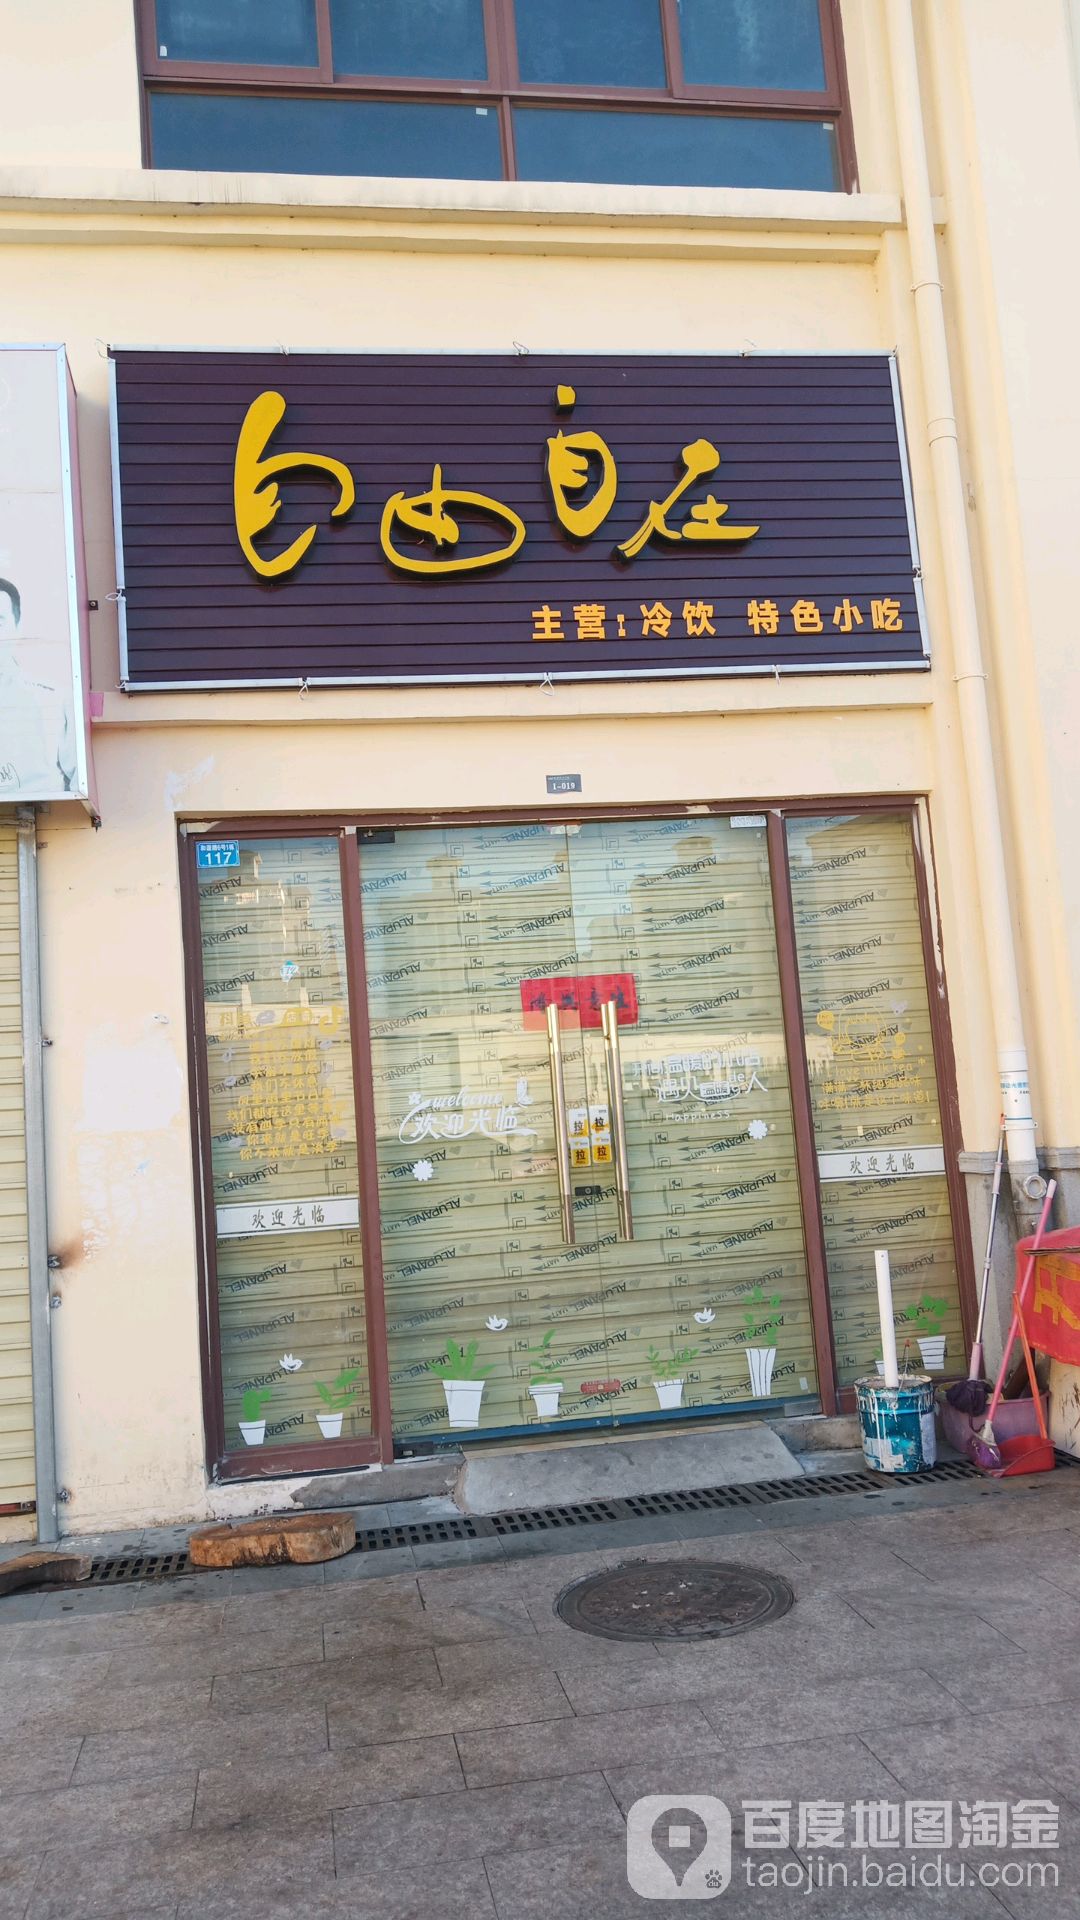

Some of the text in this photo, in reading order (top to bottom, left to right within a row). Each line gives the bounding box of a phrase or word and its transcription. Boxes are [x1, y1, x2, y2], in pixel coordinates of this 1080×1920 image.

[747, 597, 903, 636] 特色小吃
[552, 781, 576, 791] 1-019
[205, 852, 233, 866] 117
[663, 856, 717, 880] ALUPANEL
[816, 848, 867, 872] ALUPANEL
[509, 863, 565, 888] ALUPANEL
[671, 900, 725, 925] ALUPANEL
[824, 892, 874, 917] ALUPANEL
[516, 907, 572, 933] ALUPANEL
[679, 945, 732, 970] ALUPANEL
[829, 936, 882, 961] ALUPANEL
[525, 953, 579, 979] ALUPANEL
[685, 989, 740, 1015] ALUPANEL
[837, 980, 890, 1005] ALUPANEL
[400, 1105, 530, 1144] 欢迎光临
[573, 1120, 584, 1132] 拉
[595, 1116, 605, 1128] 拉
[665, 1110, 731, 1122] Happiness
[862, 1115, 913, 1142] ALUPANEL
[575, 1149, 586, 1161] 拉
[597, 1145, 607, 1157] 拉
[850, 1152, 914, 1174] 欢迎光临
[217, 1164, 278, 1193] ALUPANEL
[721, 1172, 777, 1200] ALUPANEL
[252, 1205, 325, 1228] 欢迎光临
[402, 1198, 461, 1227] ALUPANEL
[872, 1207, 926, 1234] ALUPANEL
[560, 1233, 617, 1262] ALUPANEL
[719, 1220, 774, 1249] ALUPANEL
[397, 1248, 456, 1278] ALUPANEL
[225, 1264, 287, 1293] ALUPANEL
[727, 1268, 783, 1296] ALUPANEL
[573, 1282, 626, 1311] ALUPANEL
[405, 1297, 464, 1327] ALUPANEL
[234, 1312, 295, 1342] ALUPANEL
[569, 1331, 627, 1360] ALUPANEL
